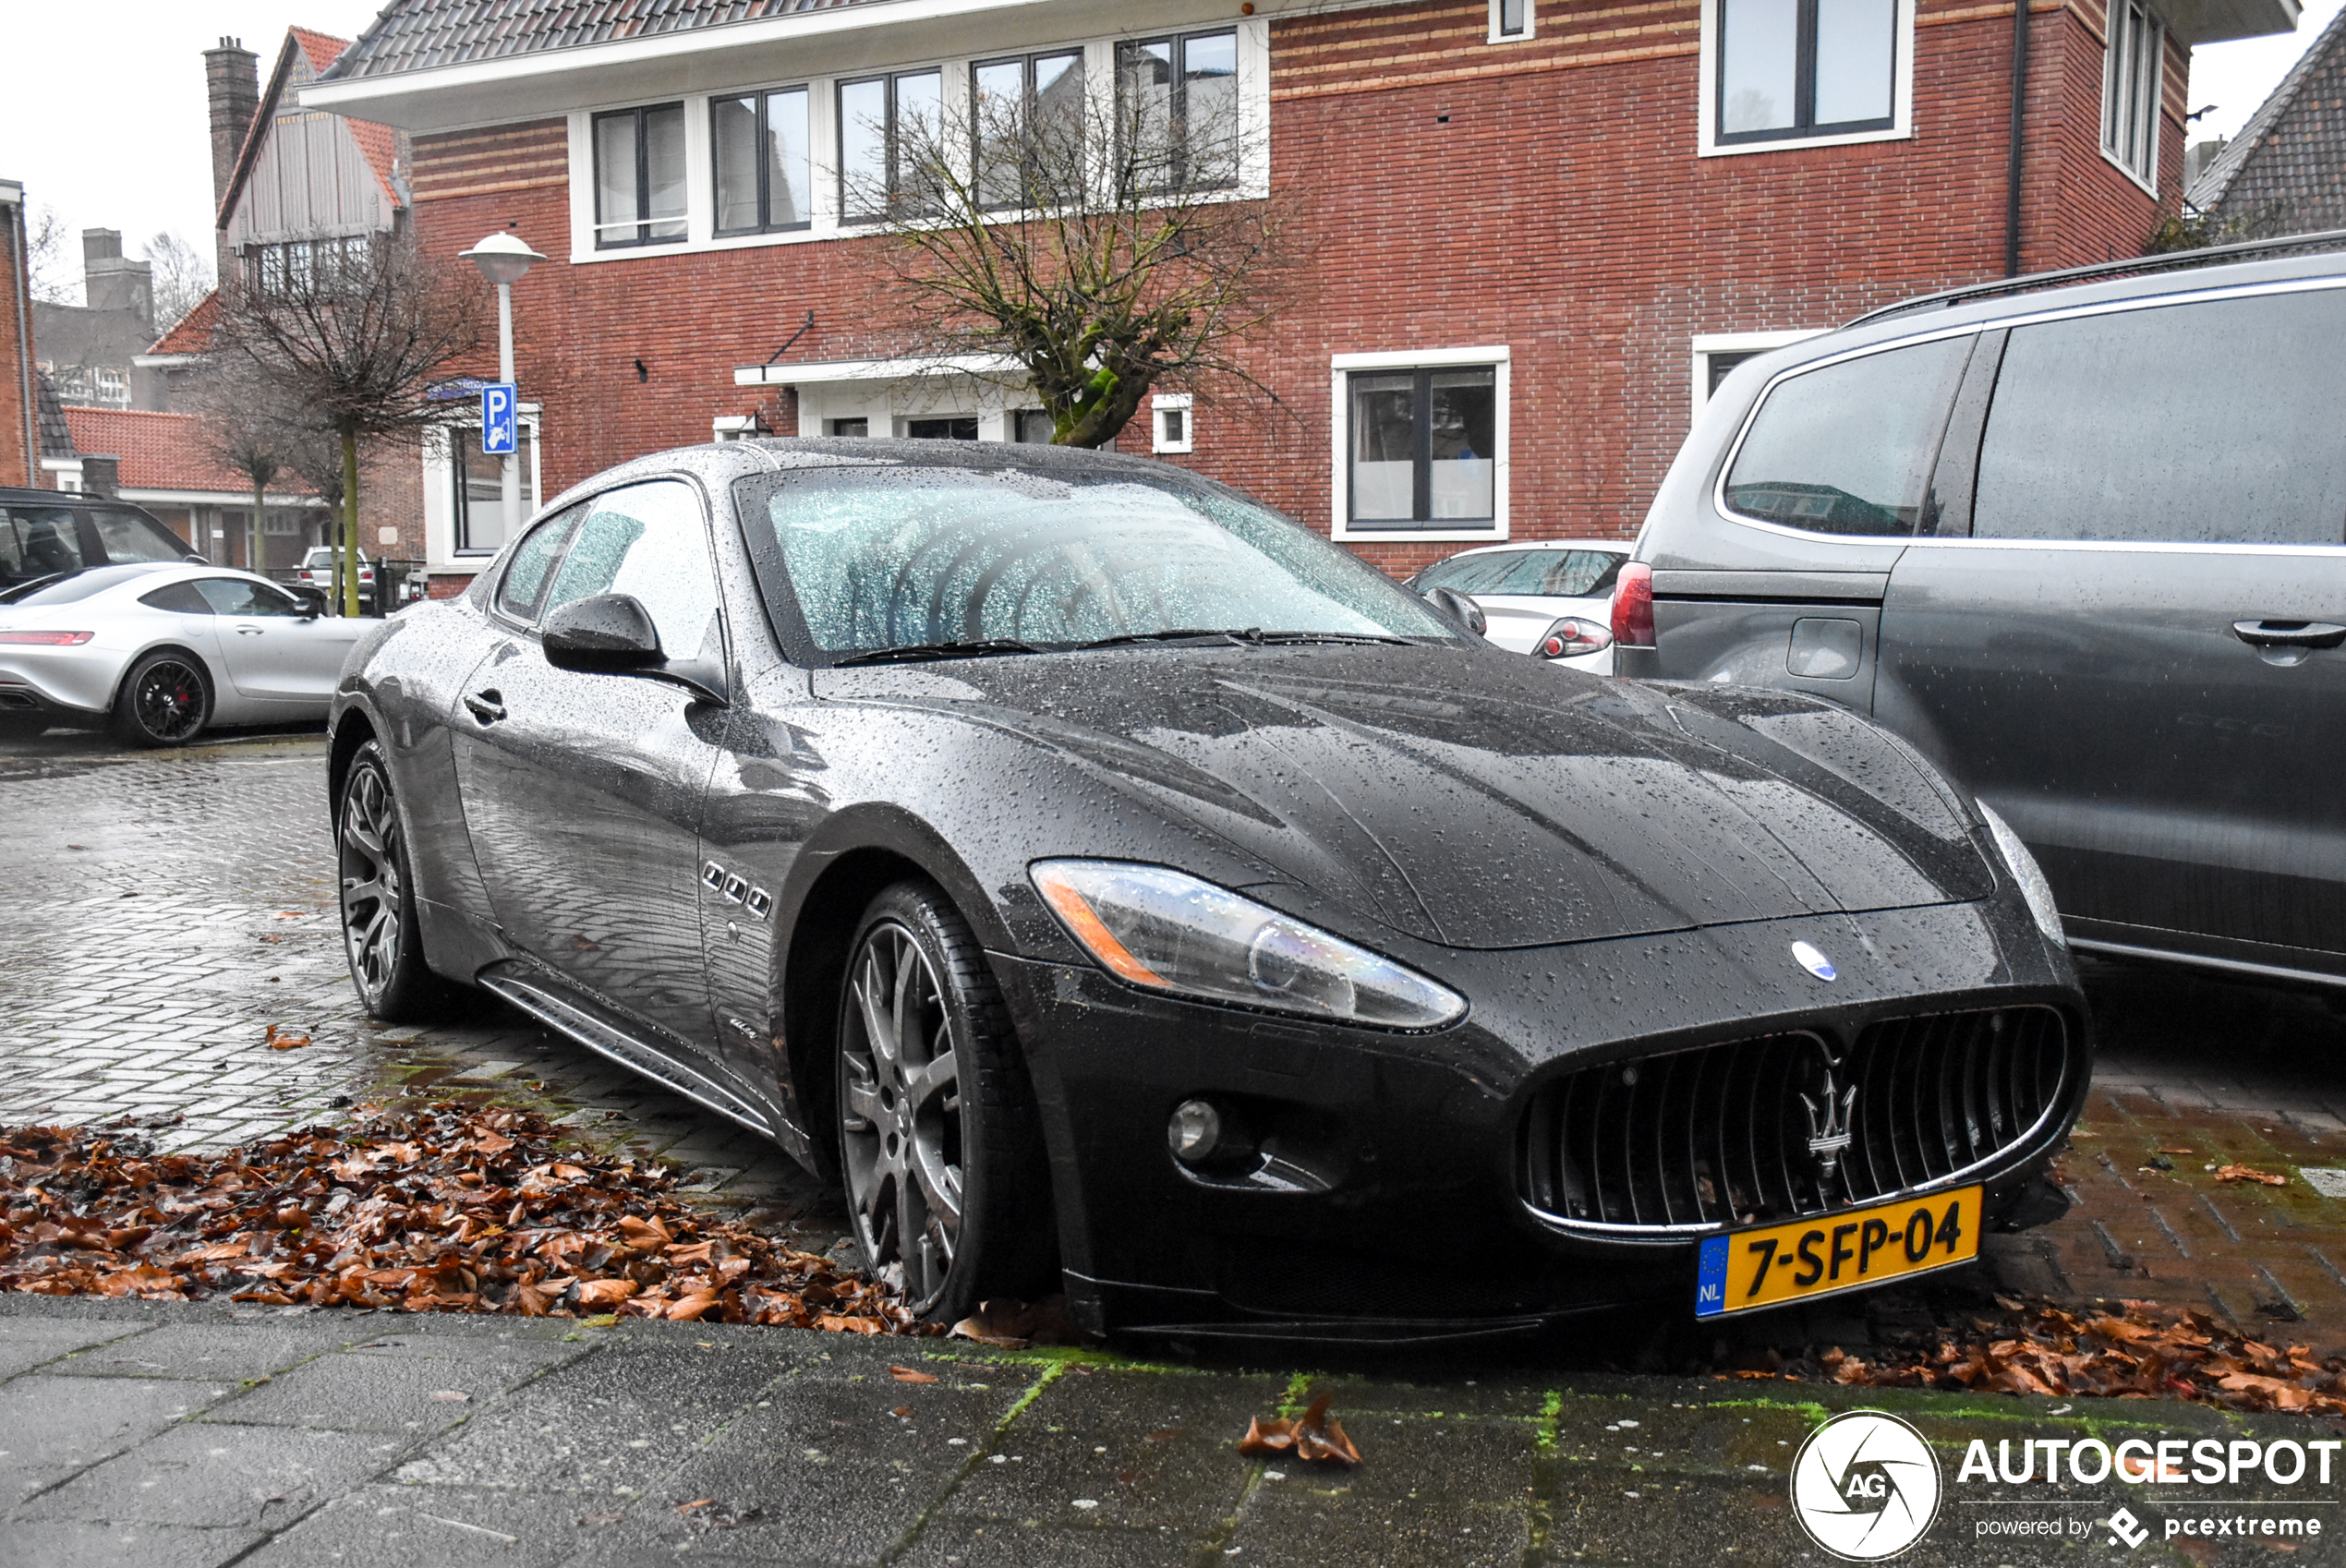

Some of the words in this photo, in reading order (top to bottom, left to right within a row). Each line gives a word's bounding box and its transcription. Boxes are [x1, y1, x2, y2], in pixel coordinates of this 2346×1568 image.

[489, 390, 507, 425] P
[1747, 1200, 1961, 1297] 7-SFP-04
[1699, 1284, 1720, 1302] NL
